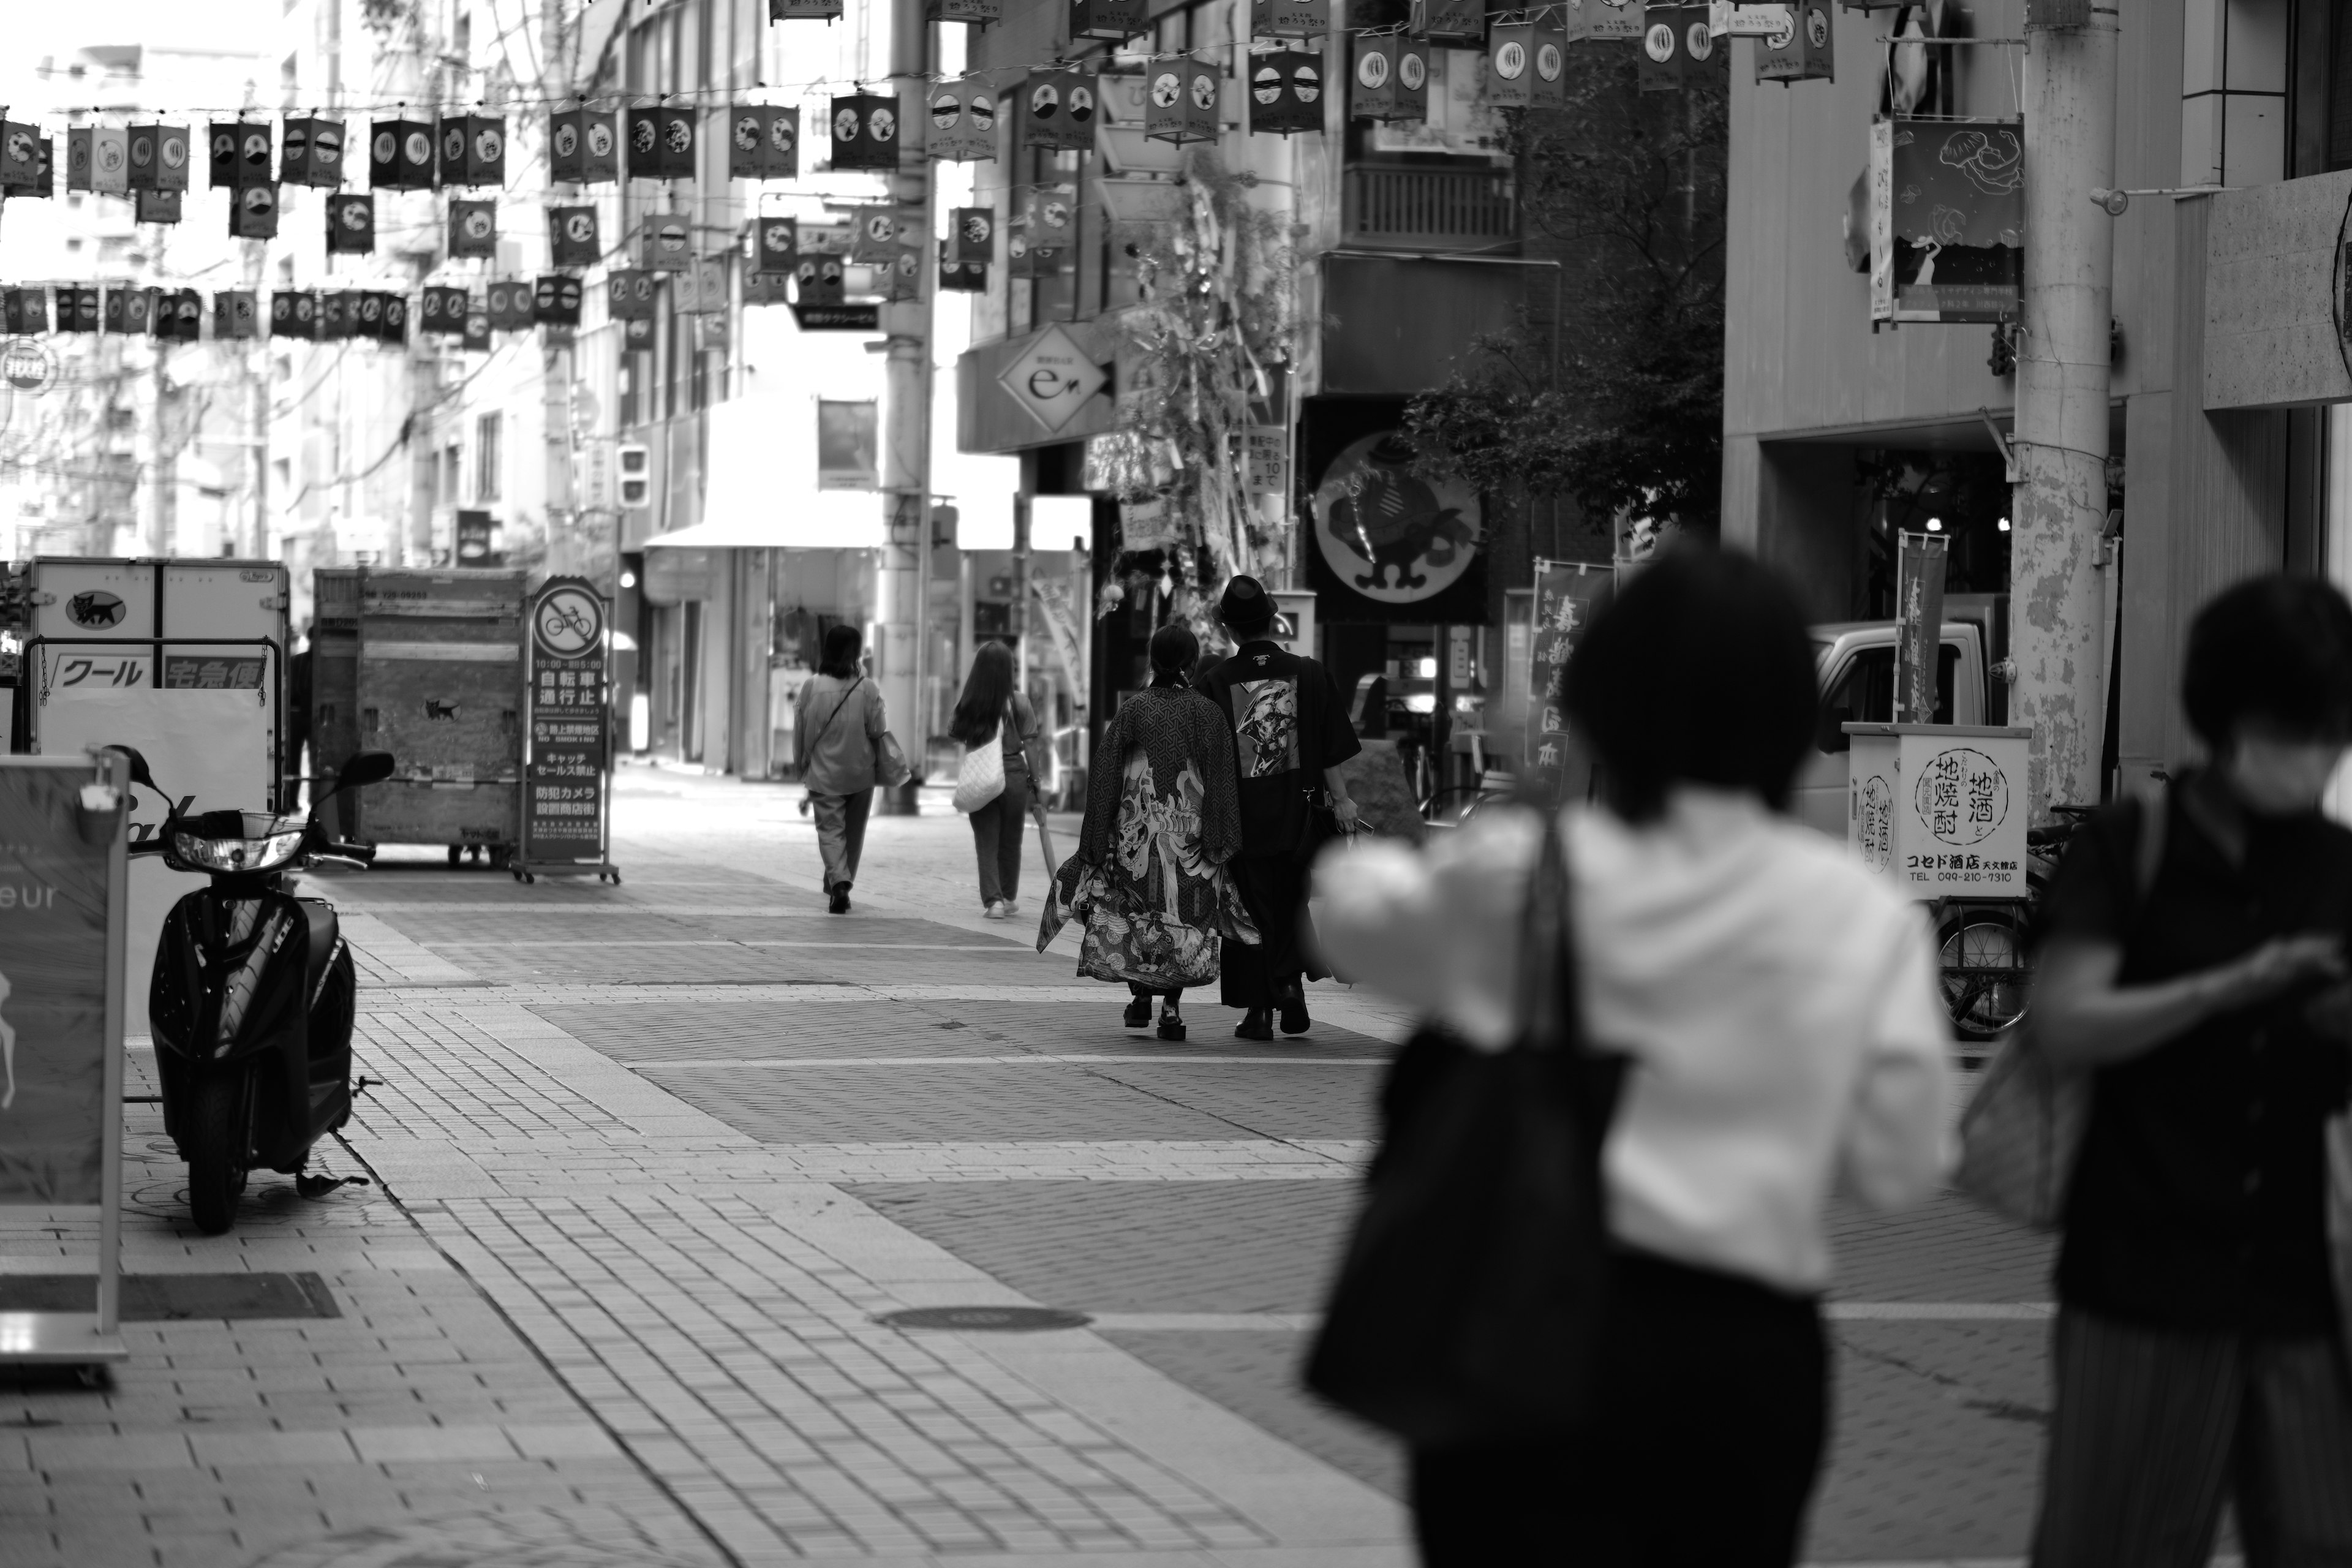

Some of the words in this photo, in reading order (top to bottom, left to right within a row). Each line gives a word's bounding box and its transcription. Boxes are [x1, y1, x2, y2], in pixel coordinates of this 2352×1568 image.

[62, 660, 143, 687] クール
[167, 660, 260, 688] 宅急便
[541, 671, 595, 687] 自転車
[540, 689, 595, 704] 通行止
[549, 724, 599, 736] 路上禁煙地区
[547, 753, 586, 764] キャッチ
[537, 765, 595, 777] セールス禁止
[536, 786, 595, 800] 防犯カメラ
[1934, 757, 1959, 834] 地焼酎
[537, 802, 595, 815] 設置商店街
[1907, 854, 1980, 870] コセド酒店
[1983, 861, 2018, 870] 天文館店
[1910, 872, 1929, 881] TEL
[1937, 872, 2011, 882] 099-210-7310
